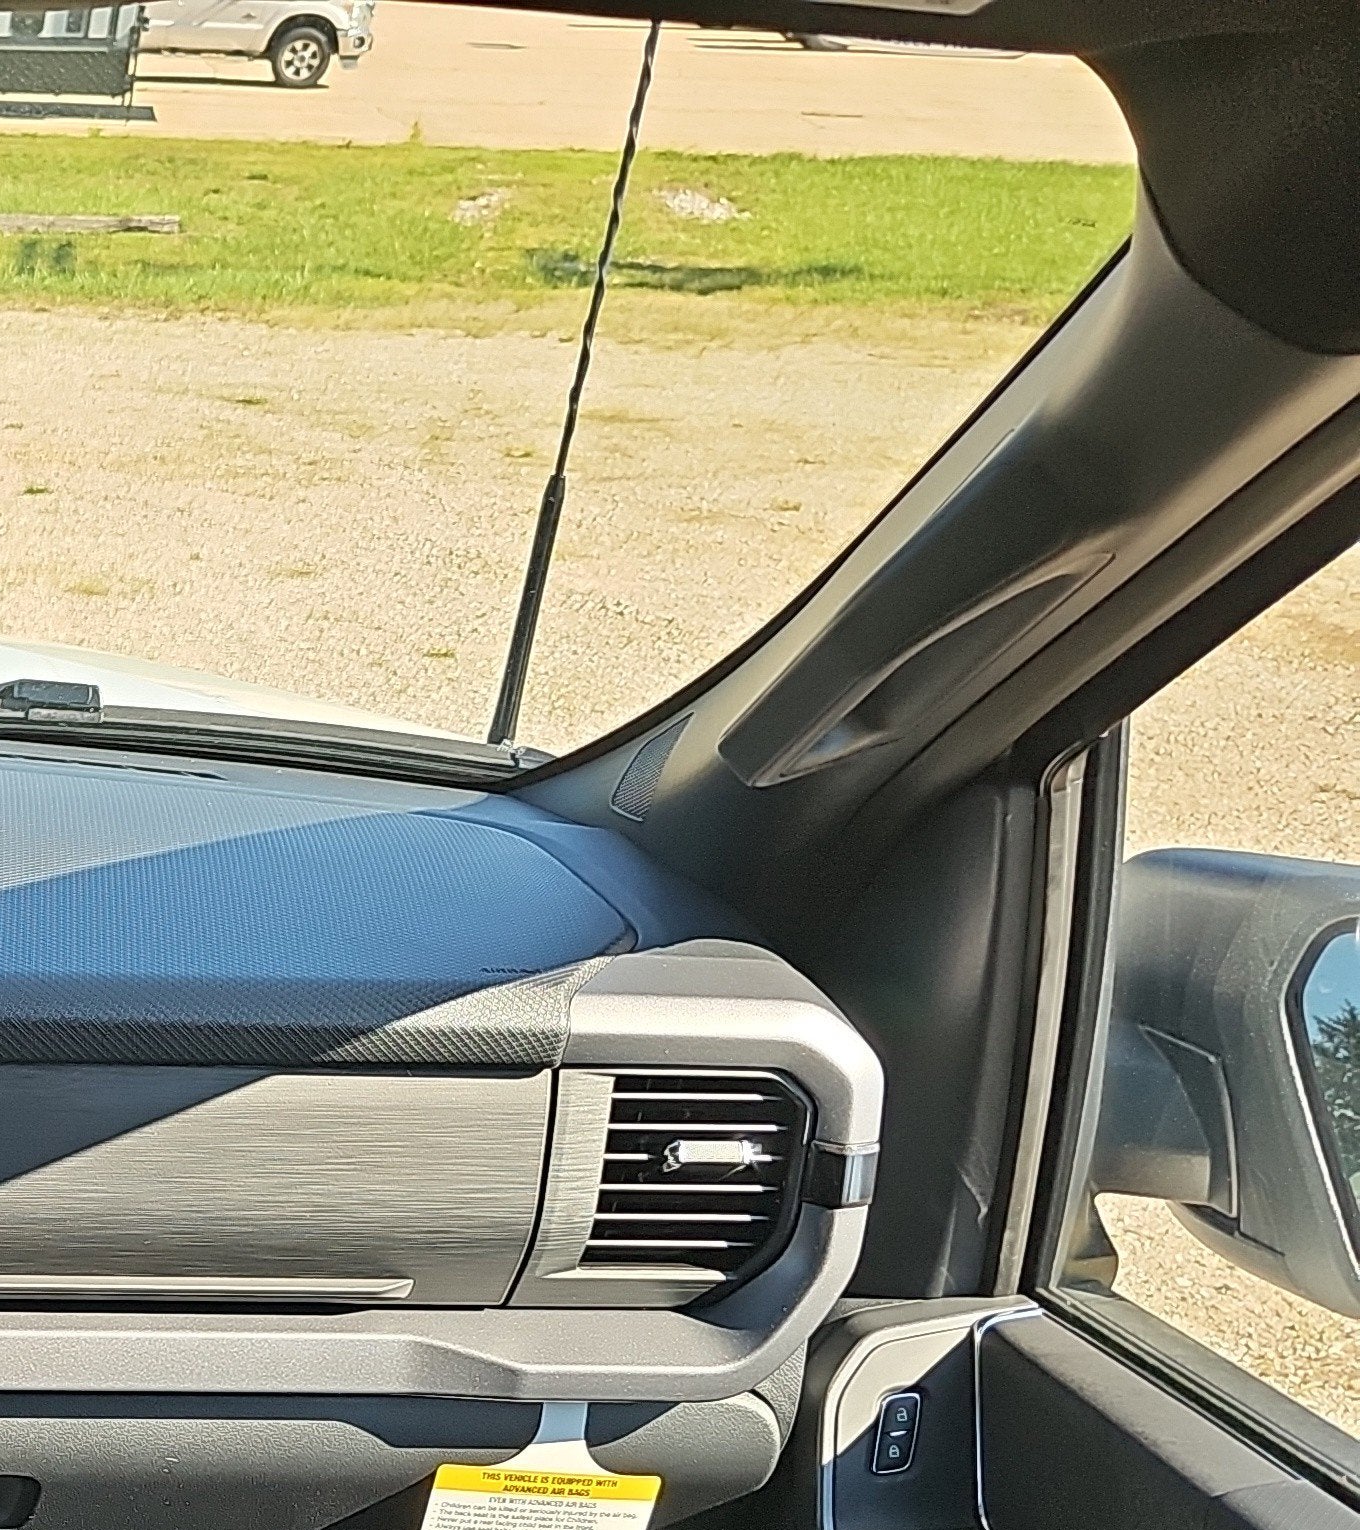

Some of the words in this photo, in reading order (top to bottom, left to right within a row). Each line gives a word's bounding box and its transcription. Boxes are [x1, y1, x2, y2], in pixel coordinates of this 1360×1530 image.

[482, 1472, 501, 1481] THIS
[504, 1473, 539, 1484] VEHICLE
[540, 1476, 549, 1484] IS
[551, 1476, 593, 1487] EQUIPPED
[595, 1479, 618, 1488] WITH
[503, 1485, 549, 1495] ADVANCED
[550, 1487, 565, 1496] AIR
[567, 1489, 591, 1497] BAGS
